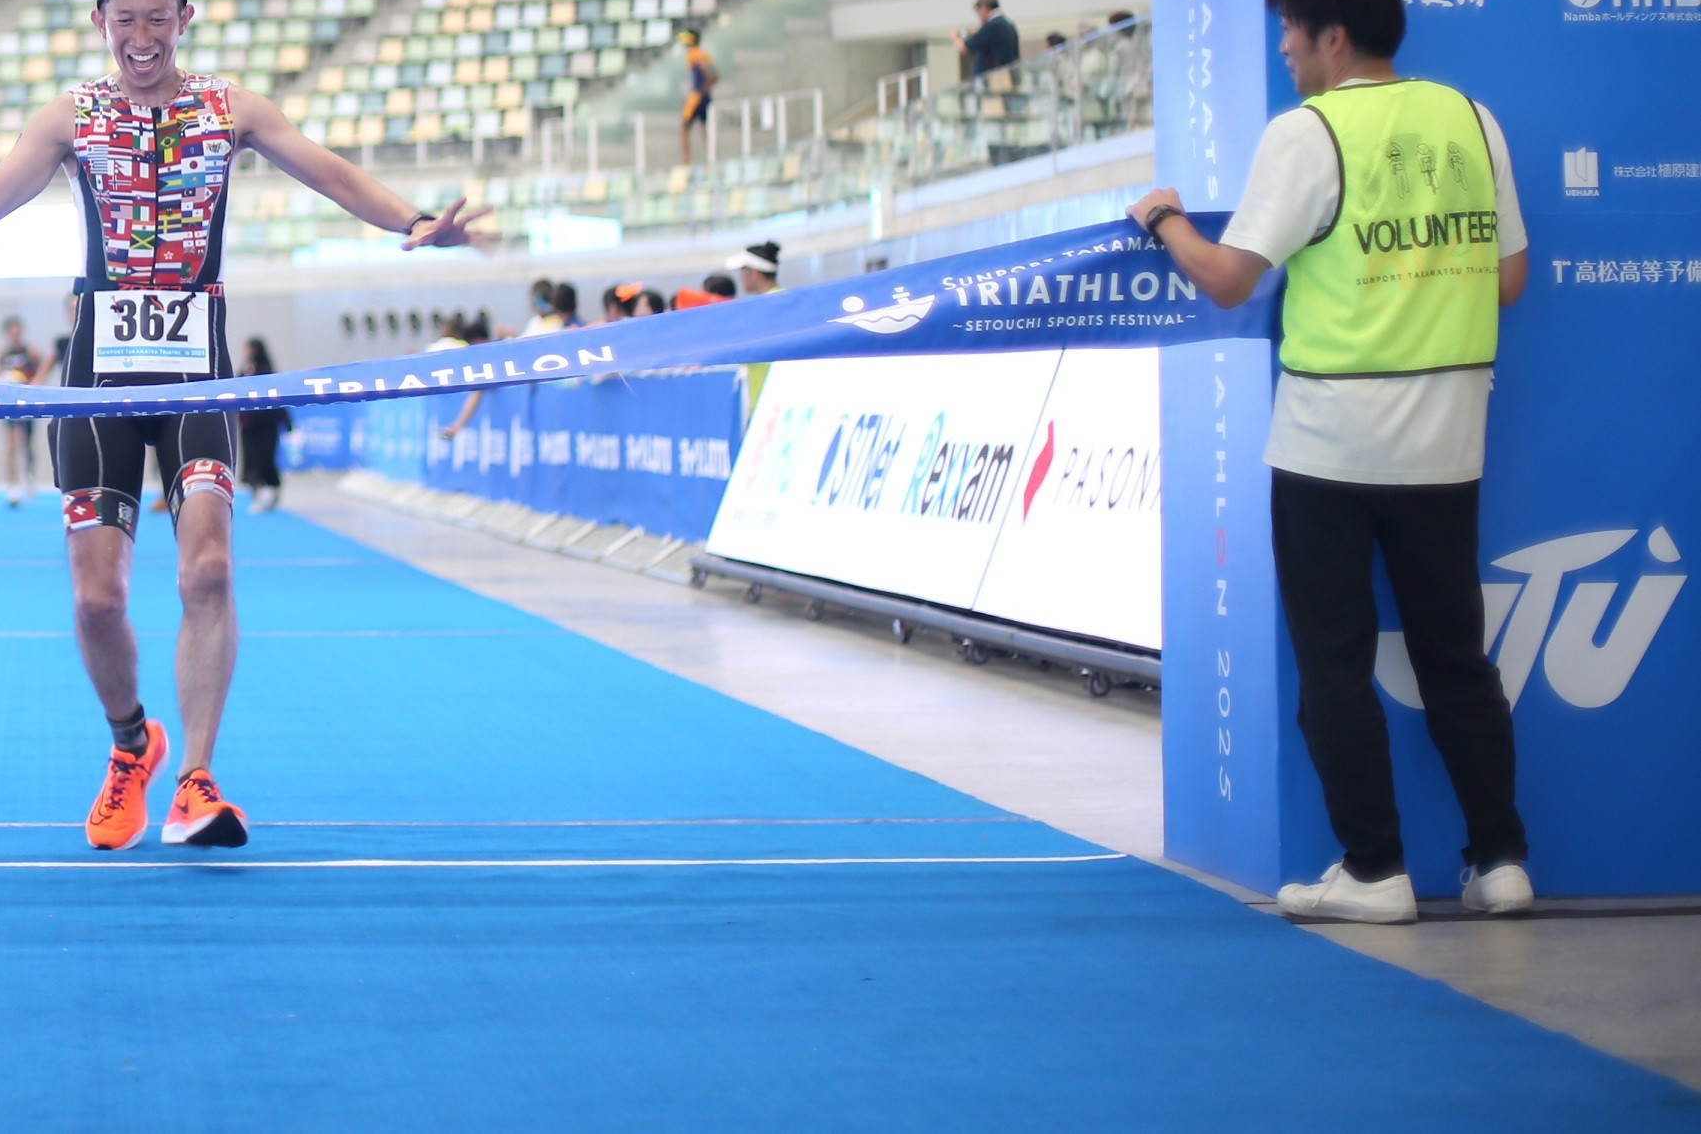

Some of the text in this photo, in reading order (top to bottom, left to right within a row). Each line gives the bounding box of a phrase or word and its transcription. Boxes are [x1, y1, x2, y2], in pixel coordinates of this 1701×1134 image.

[1565, 189, 1600, 197] UEHARA
[1613, 163, 1701, 179] 株式会社植原建
[1353, 210, 1499, 255] VOLUNTEER
[1356, 273, 1402, 286] SUNPORT
[1408, 267, 1462, 280] TAKAMATSU
[111, 297, 190, 343] 362
[1047, 314, 1104, 329] SPORTS
[828, 412, 907, 512] STNet
[900, 410, 1016, 526] Rexxam
[1216, 649, 1232, 803] 2025
